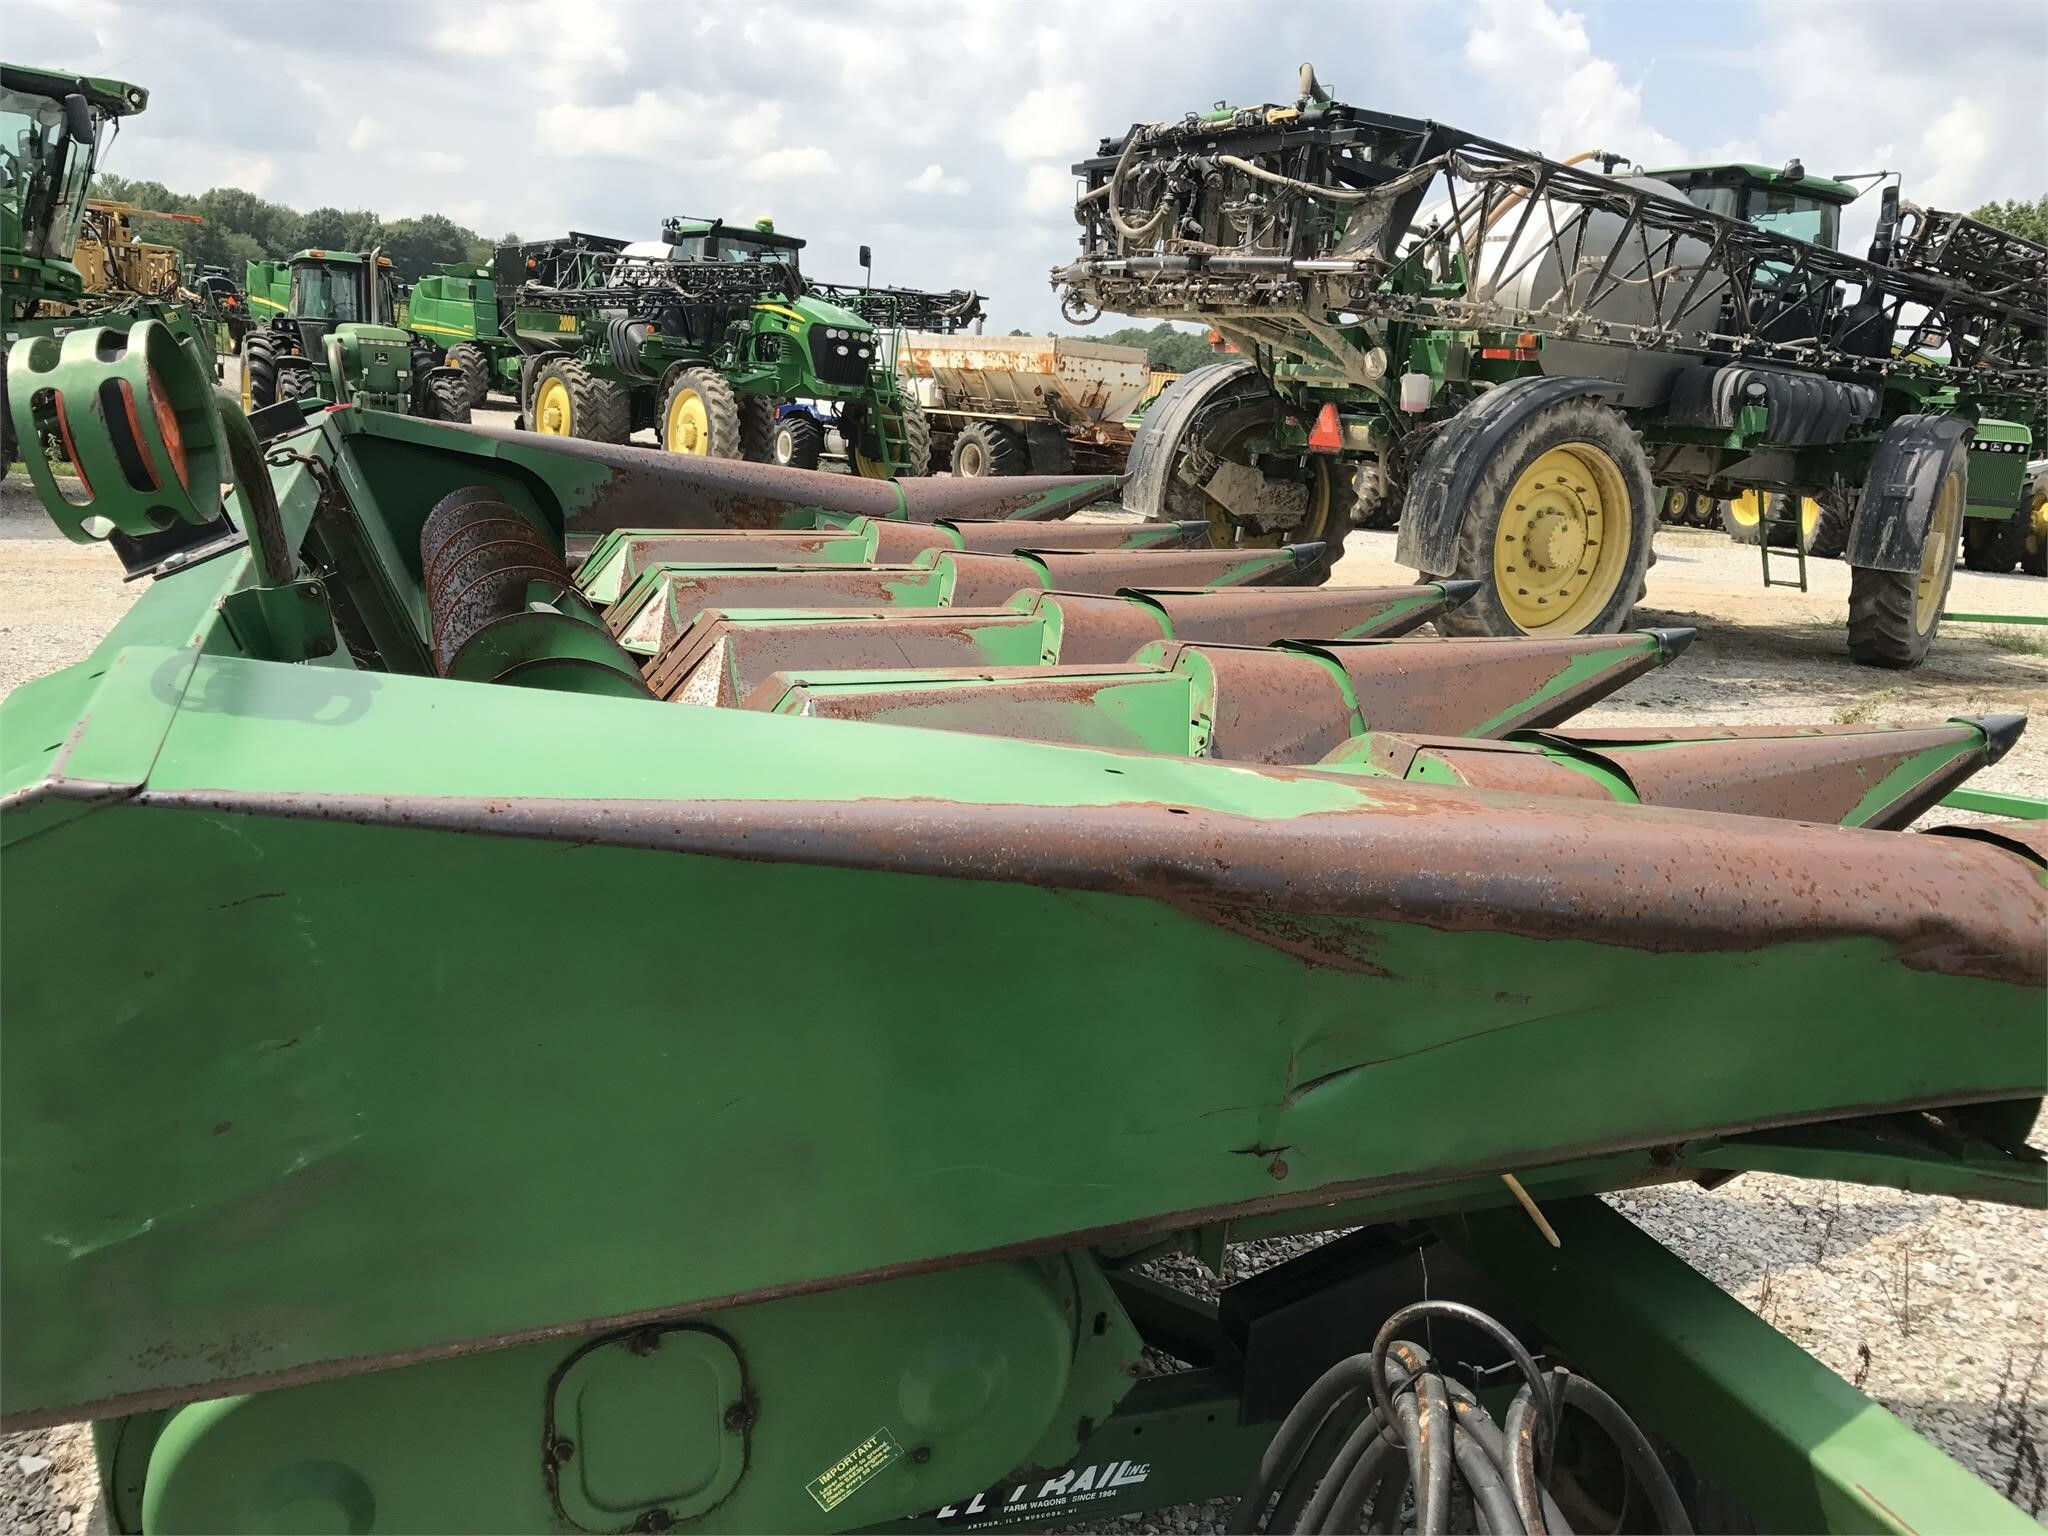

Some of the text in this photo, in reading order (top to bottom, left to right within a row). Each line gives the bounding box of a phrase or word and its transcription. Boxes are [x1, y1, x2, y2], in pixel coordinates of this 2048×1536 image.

[819, 1437, 877, 1484] IMPORTANT
[830, 1480, 845, 1492] with
[863, 1451, 883, 1467] engine
[1124, 1463, 1150, 1475] INC.
[819, 1480, 837, 1495] Lower
[837, 1463, 858, 1481] header
[825, 1487, 845, 1503] Check
[845, 1474, 862, 1489] every
[1003, 1489, 1116, 1513] FARM WAGONS SINCE 1964
[967, 1521, 1001, 1530] ARTHUR,
[1025, 1511, 1064, 1521] MUSCODA,
